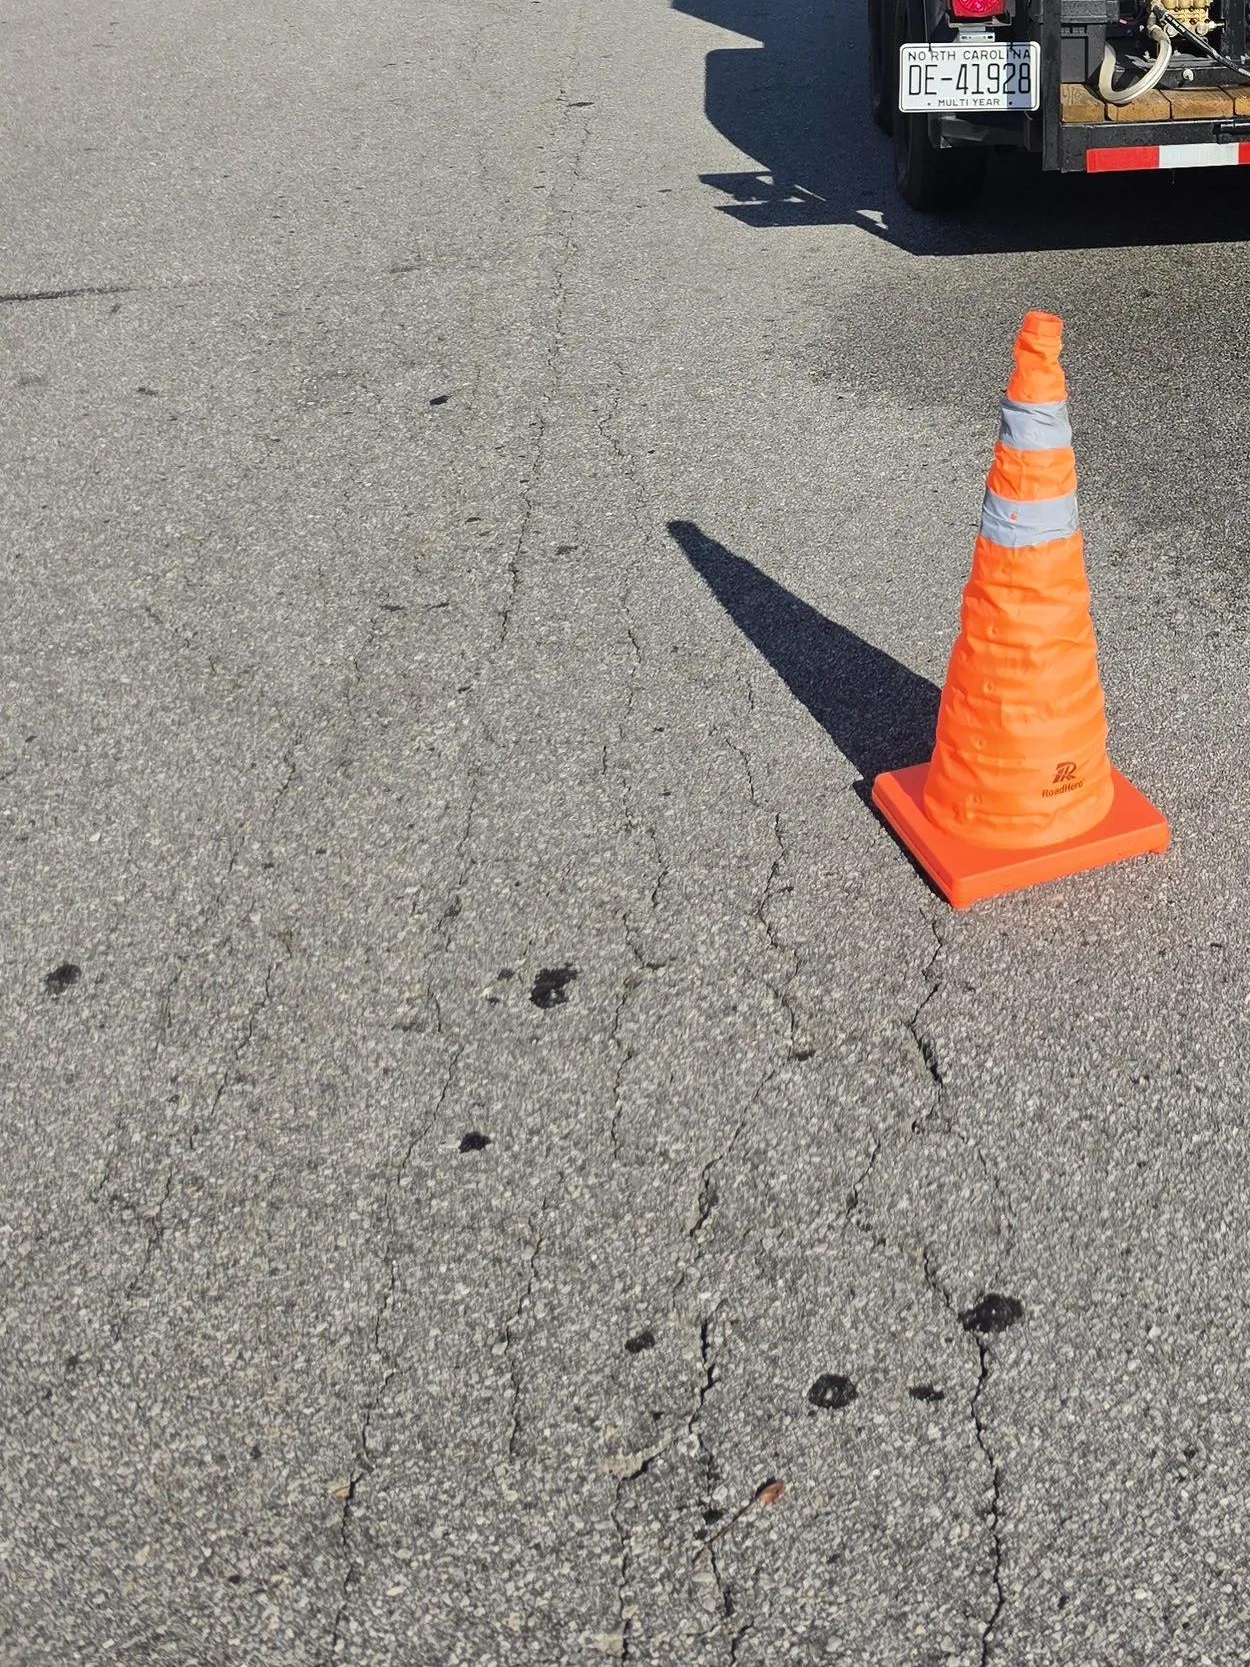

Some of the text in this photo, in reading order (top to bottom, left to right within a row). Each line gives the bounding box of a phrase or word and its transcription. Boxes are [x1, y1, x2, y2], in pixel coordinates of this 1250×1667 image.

[908, 48, 1031, 61] NORTH CAROLINA
[908, 62, 1031, 95] DE-41928
[938, 98, 1000, 107] MULTI YEAR
